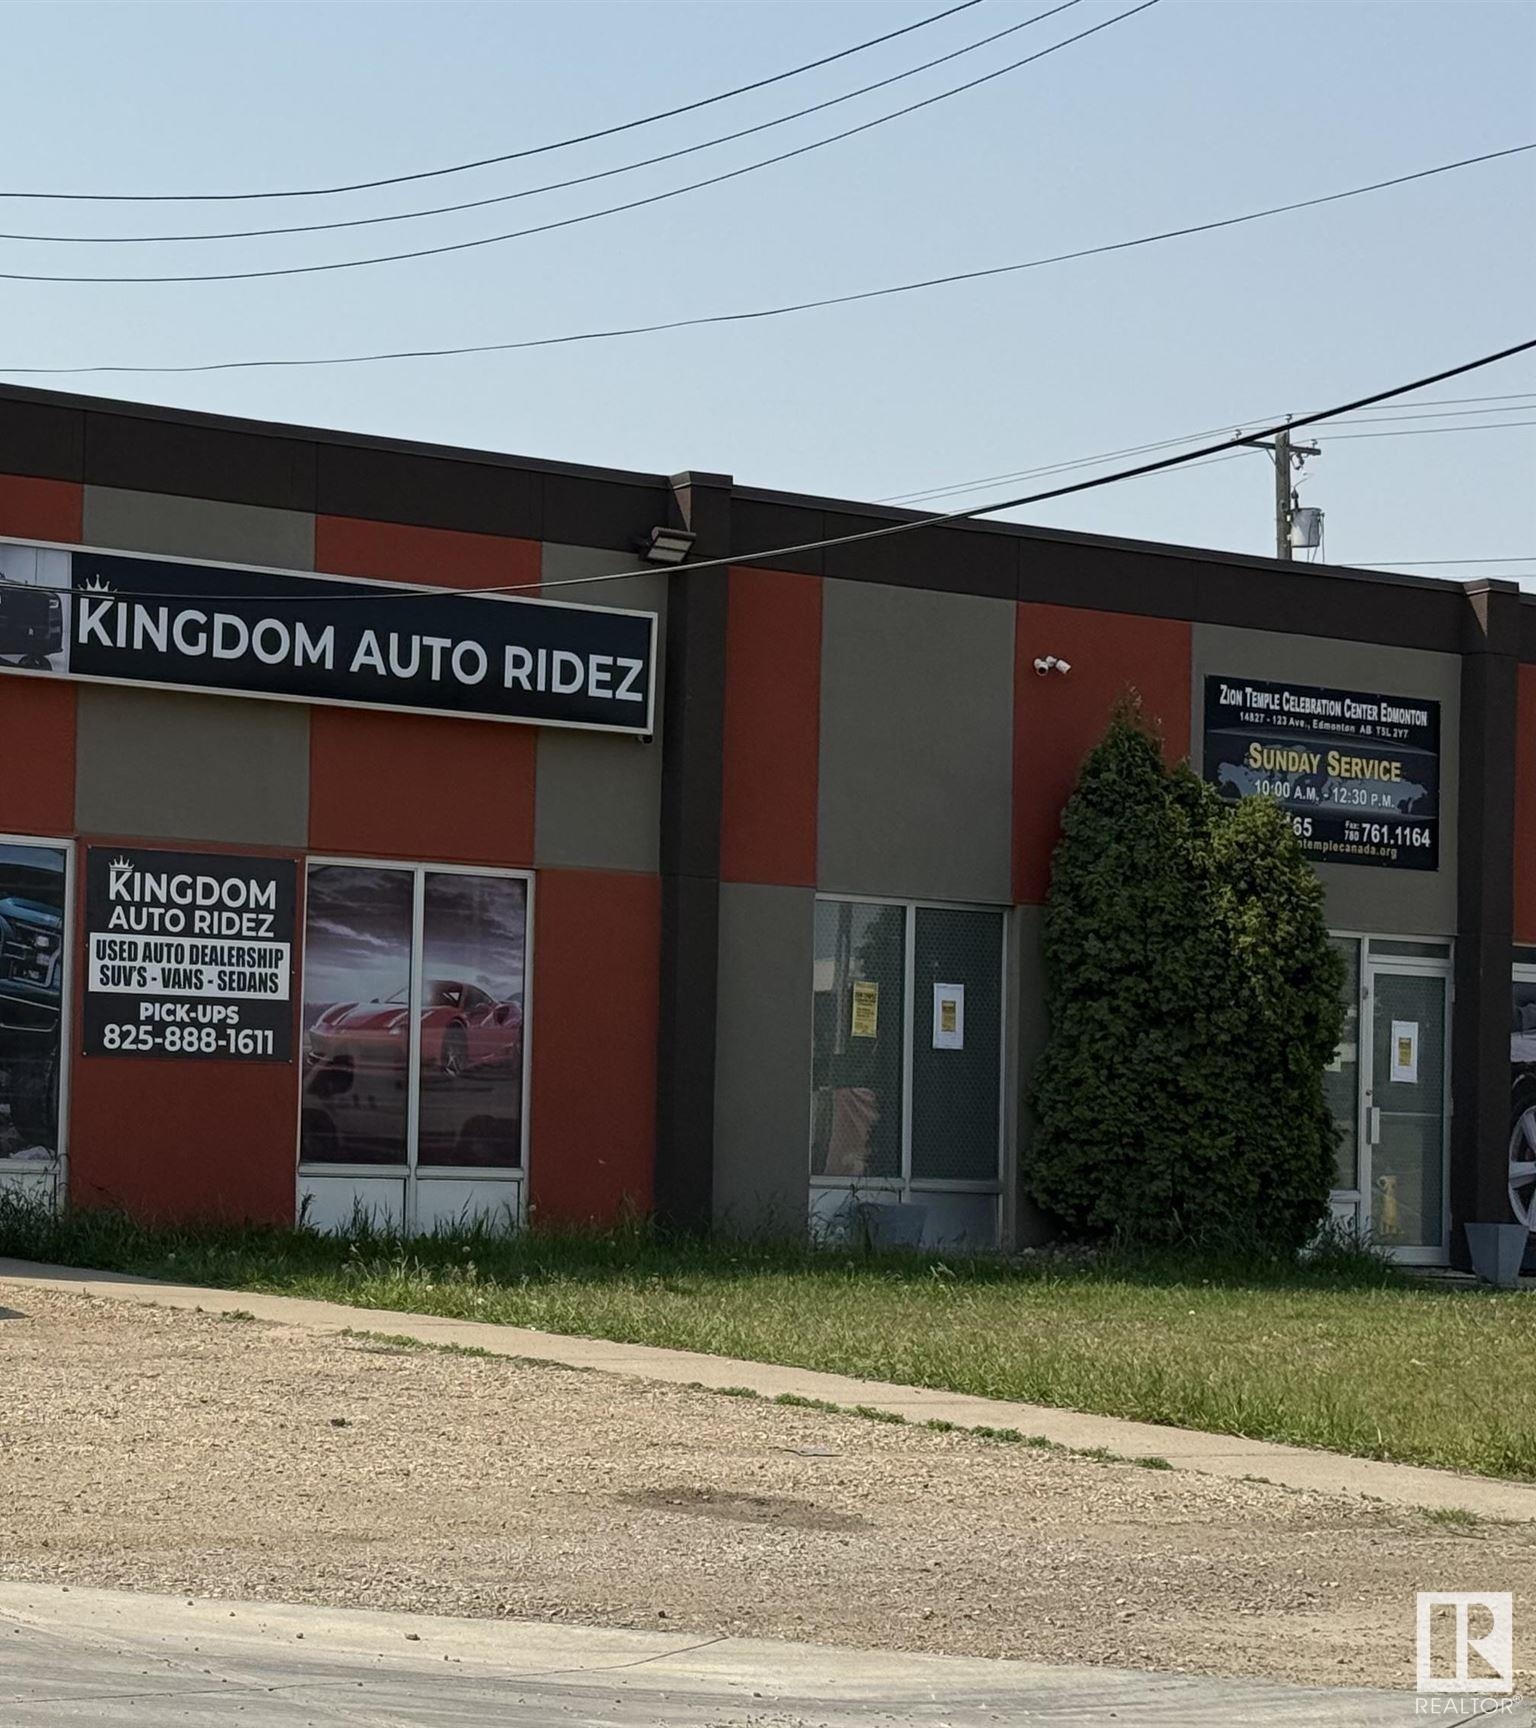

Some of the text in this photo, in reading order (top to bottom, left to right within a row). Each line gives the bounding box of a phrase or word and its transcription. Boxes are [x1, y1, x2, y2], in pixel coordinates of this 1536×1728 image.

[77, 595, 644, 703] KINGDOM AUTO RIDEZ
[1219, 684, 1428, 727] ZION TEMPLE CELEBRATION CENTER EDMONTON
[1272, 714, 1287, 726] 123
[1312, 719, 1356, 733] Edmonton
[1360, 724, 1373, 735] AB
[1249, 742, 1402, 782] SUNDAY SERVICE
[1254, 778, 1290, 799] 10:00
[1293, 784, 1320, 802] A.M.
[1333, 787, 1367, 806] 12:30
[1371, 793, 1395, 809] P.M.
[1361, 822, 1432, 848] 761.1164
[109, 870, 277, 910] KINGDOM
[108, 905, 275, 938] AUTO RIDEZ
[95, 939, 284, 969] USED AUTO DEALERSHIP
[99, 964, 148, 988] SUV'S
[161, 967, 204, 990] VANS
[217, 970, 279, 994] SEDANS
[139, 1002, 240, 1025] PICK-UPS
[103, 1022, 274, 1055] 825-888-1611
